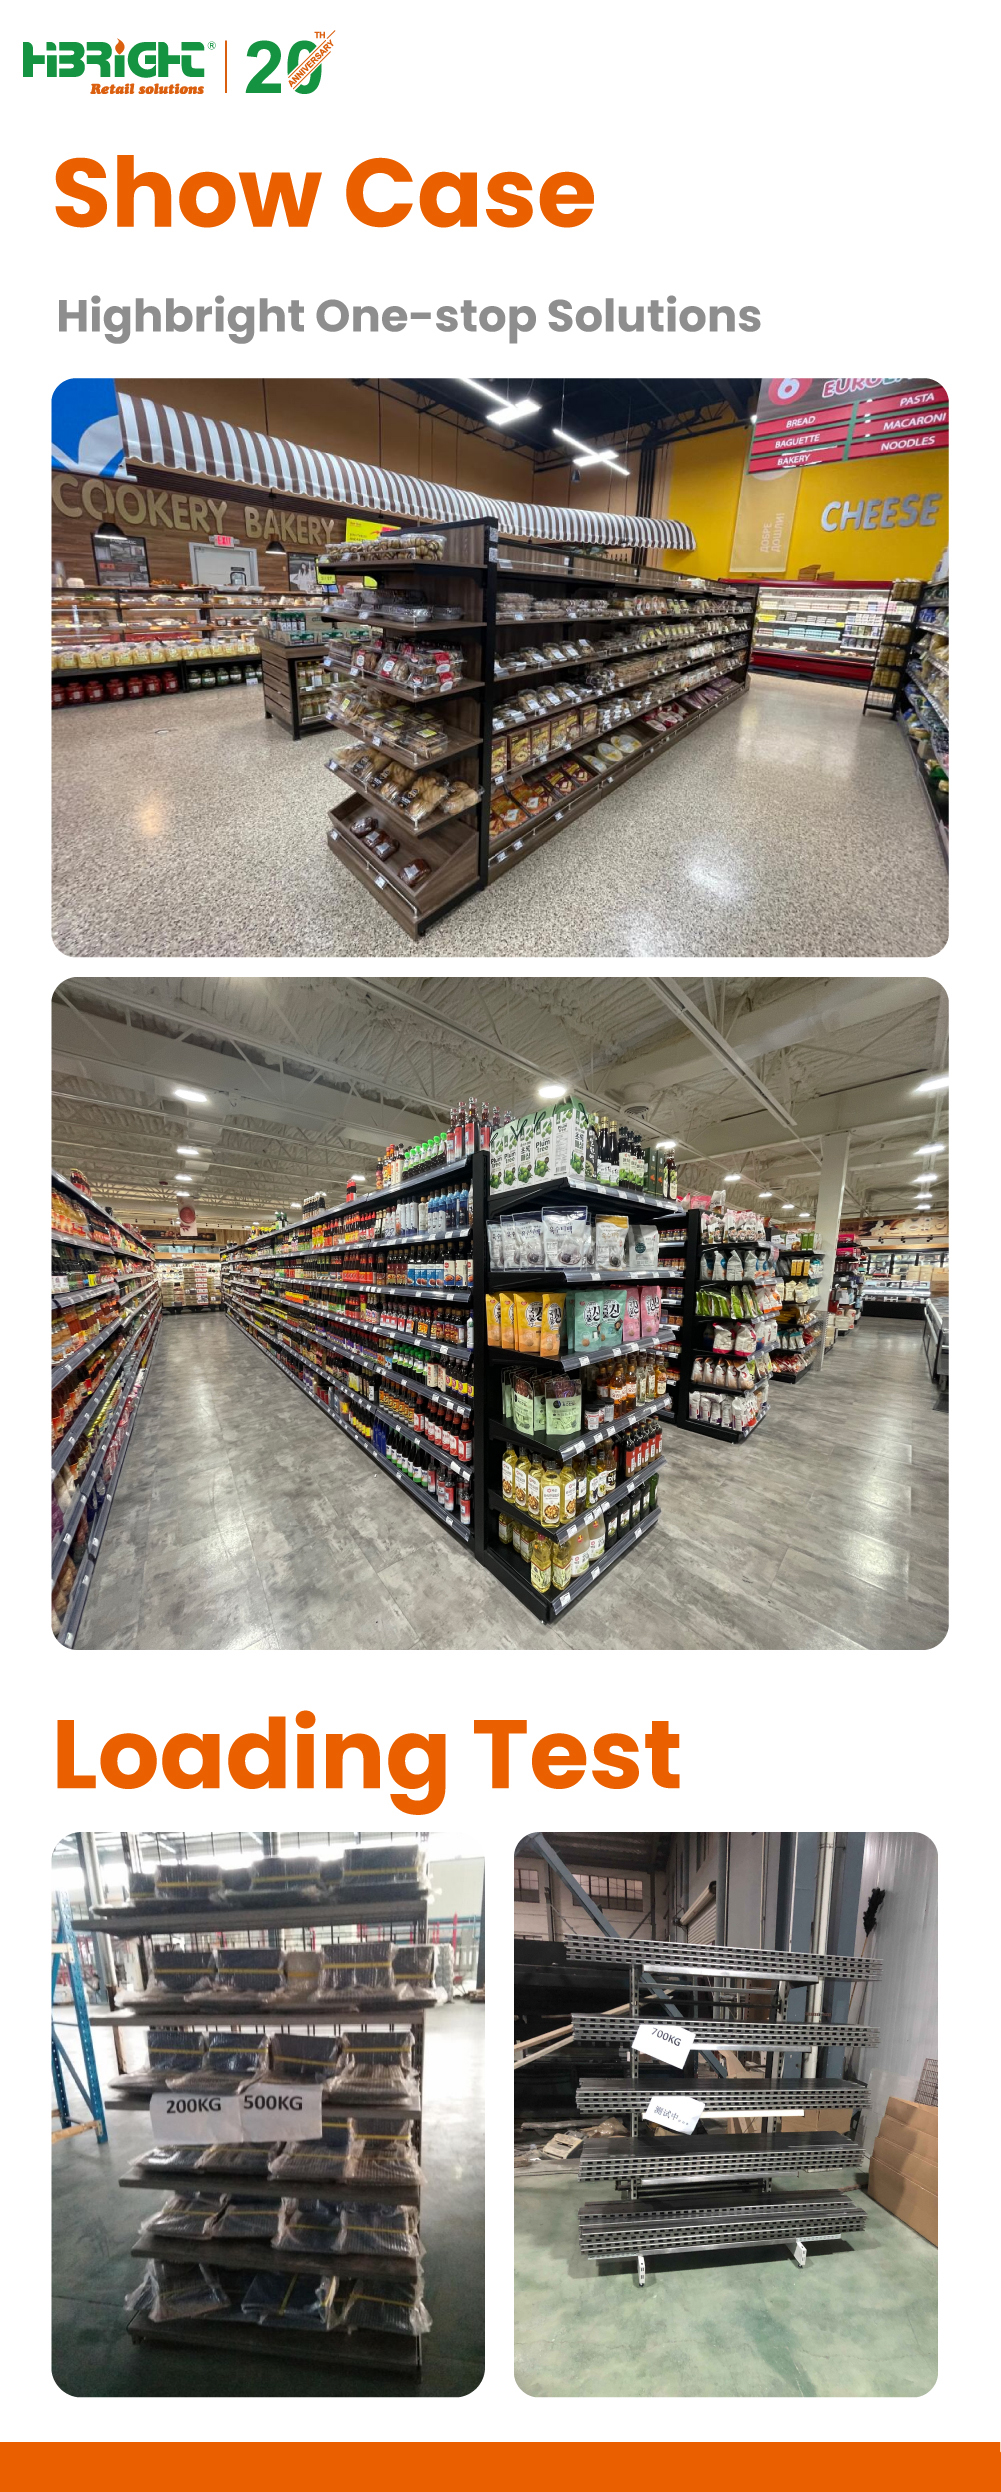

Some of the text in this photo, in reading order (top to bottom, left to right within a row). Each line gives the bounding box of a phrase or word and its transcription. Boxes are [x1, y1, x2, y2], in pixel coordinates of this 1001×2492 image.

[899, 392, 935, 407] PASTA
[786, 415, 816, 429] BREAD
[883, 412, 947, 431] MACARONI
[774, 433, 820, 449] BAGUETTE
[880, 436, 936, 451] NOODLES
[777, 453, 810, 467] BAKERY
[51, 473, 335, 545] COOKERY BAKERY
[820, 492, 942, 532] CHEESE
[217, 535, 232, 547] EXIT
[536, 1139, 550, 1148] Plum
[651, 2027, 682, 2047] 700KG
[166, 2097, 221, 2114] 200KG
[243, 2094, 303, 2111] 500KG
